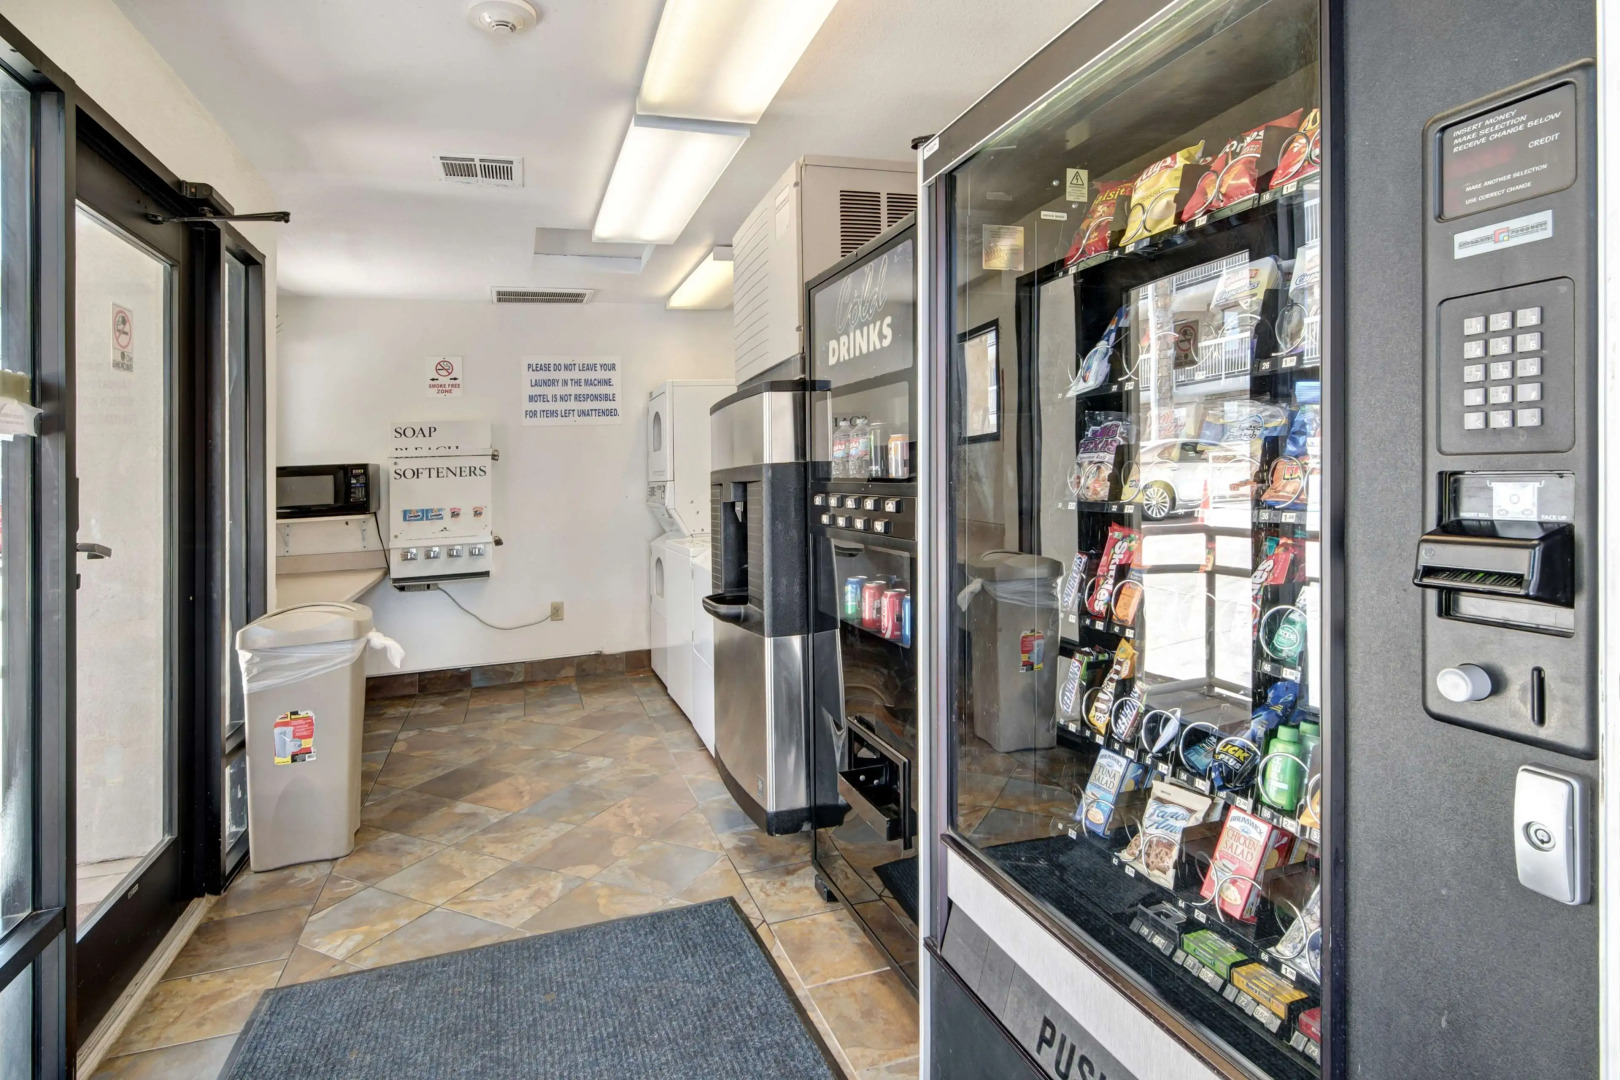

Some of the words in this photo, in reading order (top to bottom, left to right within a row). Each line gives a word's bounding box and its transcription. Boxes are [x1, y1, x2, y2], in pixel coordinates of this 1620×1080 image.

[1452, 136, 1487, 153] RECEIVE
[1488, 123, 1525, 141] CHANGE
[1527, 111, 1562, 128] BELOW
[1453, 121, 1483, 137] INSERT
[1484, 109, 1517, 126] MONEY
[1453, 131, 1477, 145] MAKE
[1479, 114, 1528, 136] SELECTION
[1528, 132, 1560, 148] CREDIT
[1465, 182, 1482, 192] MAKE
[1483, 174, 1512, 187] ANOTHER
[1512, 163, 1548, 179] SELECTION
[1465, 196, 1477, 205] USE
[1478, 188, 1505, 201] CORRECT
[1506, 181, 1532, 193] CHANGE
[836, 255, 888, 334] Cold
[828, 315, 893, 366] DRINKS
[527, 363, 552, 372] PLEASE
[553, 363, 562, 372] DO
[563, 363, 577, 372] NOT
[578, 363, 598, 372] LEAVE
[599, 363, 616, 372] YOUR
[530, 378, 560, 387] LAUNDRY
[562, 378, 568, 387] IN
[570, 378, 582, 387] THE
[584, 378, 614, 387] MACHINE.
[528, 394, 550, 403] MOTEL
[552, 394, 558, 402] IS
[559, 394, 572, 402] NOT
[574, 393, 616, 402] RESPONSIBLE
[525, 410, 538, 418] FOR
[539, 410, 559, 418] ITEMS
[560, 409, 576, 418] LEFT
[577, 408, 620, 418] UNATTENDED.
[394, 426, 437, 439] SOAP
[394, 465, 487, 480] SOFTENERS
[1219, 754, 1242, 772] PLUS
[1093, 773, 1115, 790] SALAD
[1097, 764, 1116, 782] TUNA
[1230, 815, 1264, 836] BRUNSWICK
[1226, 828, 1258, 852] CHICKEN
[1223, 839, 1254, 862] SALAD
[1178, 900, 1185, 908] 64
[1260, 952, 1269, 962] 66
[1238, 996, 1247, 1005] 72
[1035, 1014, 1107, 1080] PUS
[1308, 1045, 1318, 1056] 73
